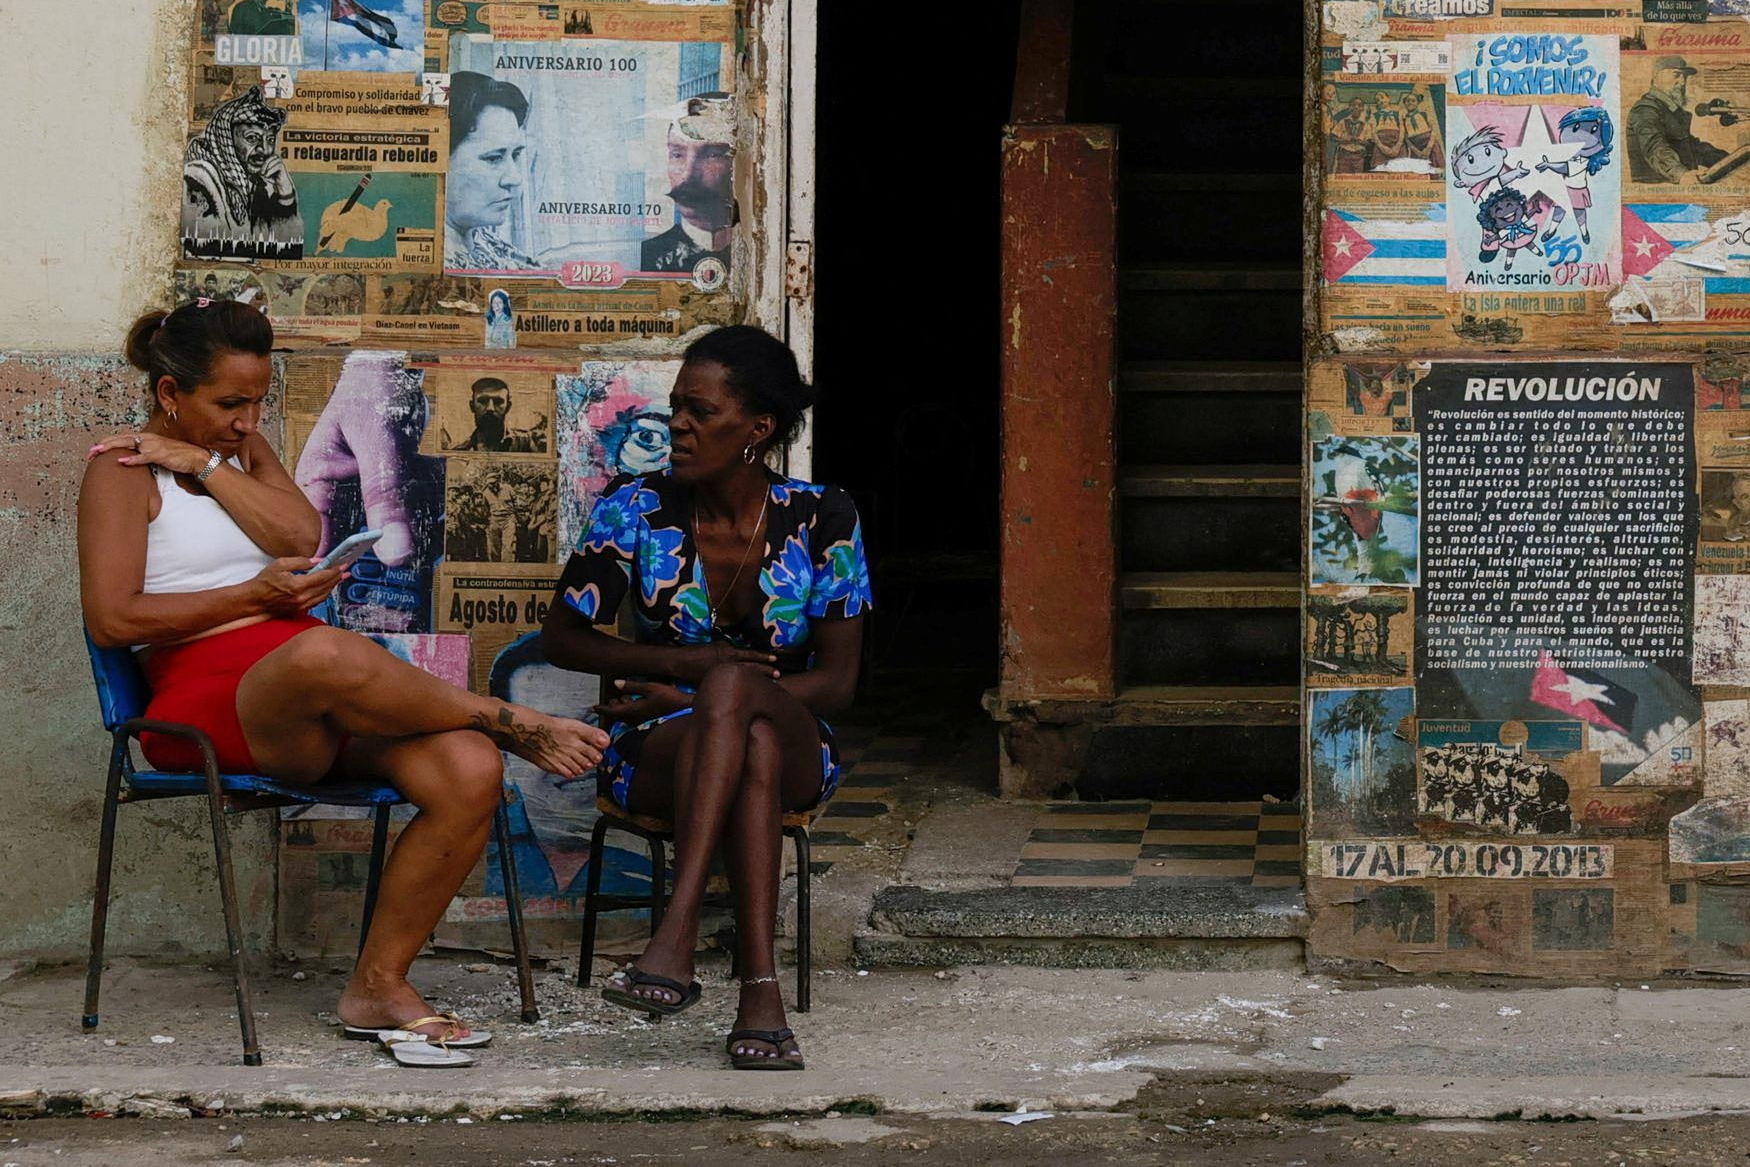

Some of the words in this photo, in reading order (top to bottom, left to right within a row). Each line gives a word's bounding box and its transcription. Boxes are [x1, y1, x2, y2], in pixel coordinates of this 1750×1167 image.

[1657, 28, 1741, 47] Granma
[216, 36, 302, 64] GLORIA
[1477, 35, 1588, 64] ¡SOMOS
[496, 56, 604, 71] ANIVERSARIO
[609, 56, 637, 71] 100
[1455, 67, 1486, 95] EL
[305, 133, 350, 142] victoria
[354, 134, 421, 144] estratégica
[294, 146, 377, 162] retaguardia
[383, 148, 437, 163] rebelde
[538, 201, 630, 215] ANIVERSARIO
[637, 202, 661, 216] 170
[571, 264, 612, 283] 2023
[1465, 269, 1551, 286] Aniversario
[1553, 263, 1610, 287] OPJM
[516, 315, 569, 332] Astillero
[575, 320, 581, 331] a
[586, 318, 614, 332] toda
[618, 316, 674, 336] máquina
[1464, 372, 1661, 401] REVOLUCIÓN
[1513, 409, 1555, 419] sentido
[1557, 409, 1575, 419] del
[1578, 409, 1628, 419] momento
[1631, 409, 1684, 421] histórico;
[450, 593, 517, 628] Agosto
[1421, 723, 1471, 733] Juventud
[1330, 845, 1365, 876] 17
[1368, 846, 1420, 877] AL
[1425, 845, 1605, 877] 20.09.2013
